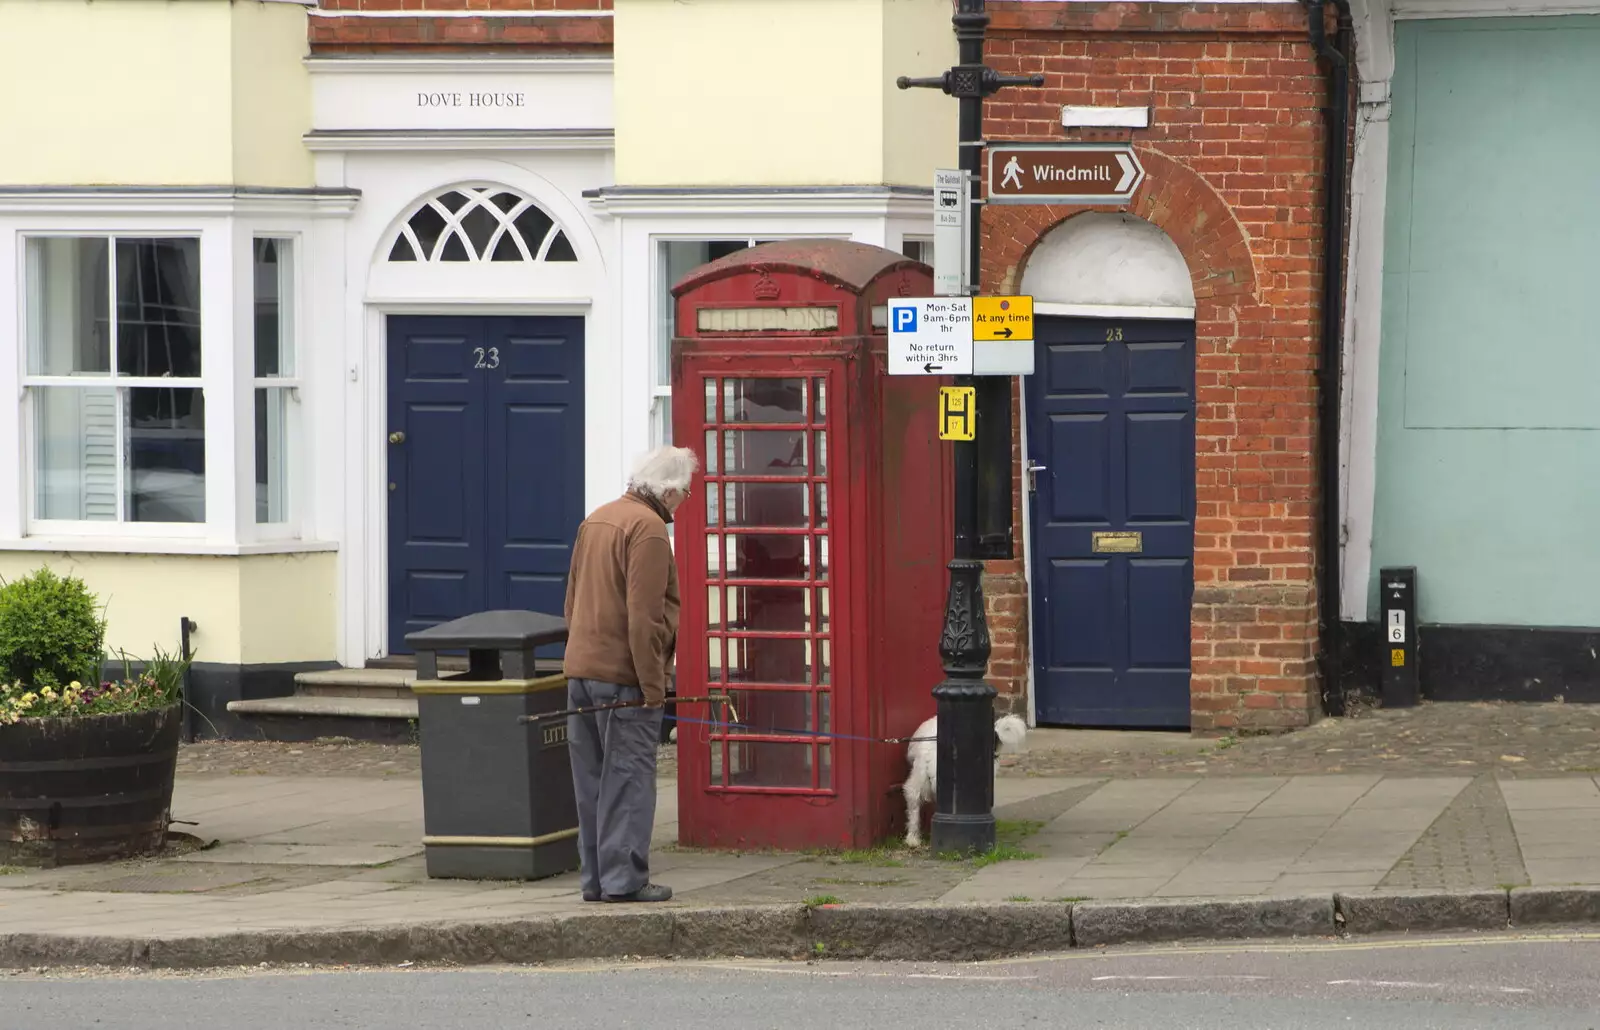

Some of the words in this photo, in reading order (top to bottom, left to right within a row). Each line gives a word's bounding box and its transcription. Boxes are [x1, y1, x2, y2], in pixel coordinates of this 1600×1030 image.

[417, 93, 461, 107] DOVE
[469, 93, 525, 107] HOUSE
[1033, 165, 1111, 181] Windmill
[926, 303, 967, 312] Mon-Sat
[898, 309, 914, 331] P
[923, 314, 971, 324] 9am-6pm
[976, 313, 987, 322] At
[989, 315, 1005, 324] any
[1008, 313, 1030, 322] time
[940, 325, 953, 333] 1hr
[1106, 327, 1123, 341] 23
[909, 343, 923, 352] No
[926, 343, 955, 352] return
[473, 346, 500, 369] 23
[905, 353, 935, 362] within
[938, 353, 959, 362] 3hrs
[944, 393, 968, 435] H
